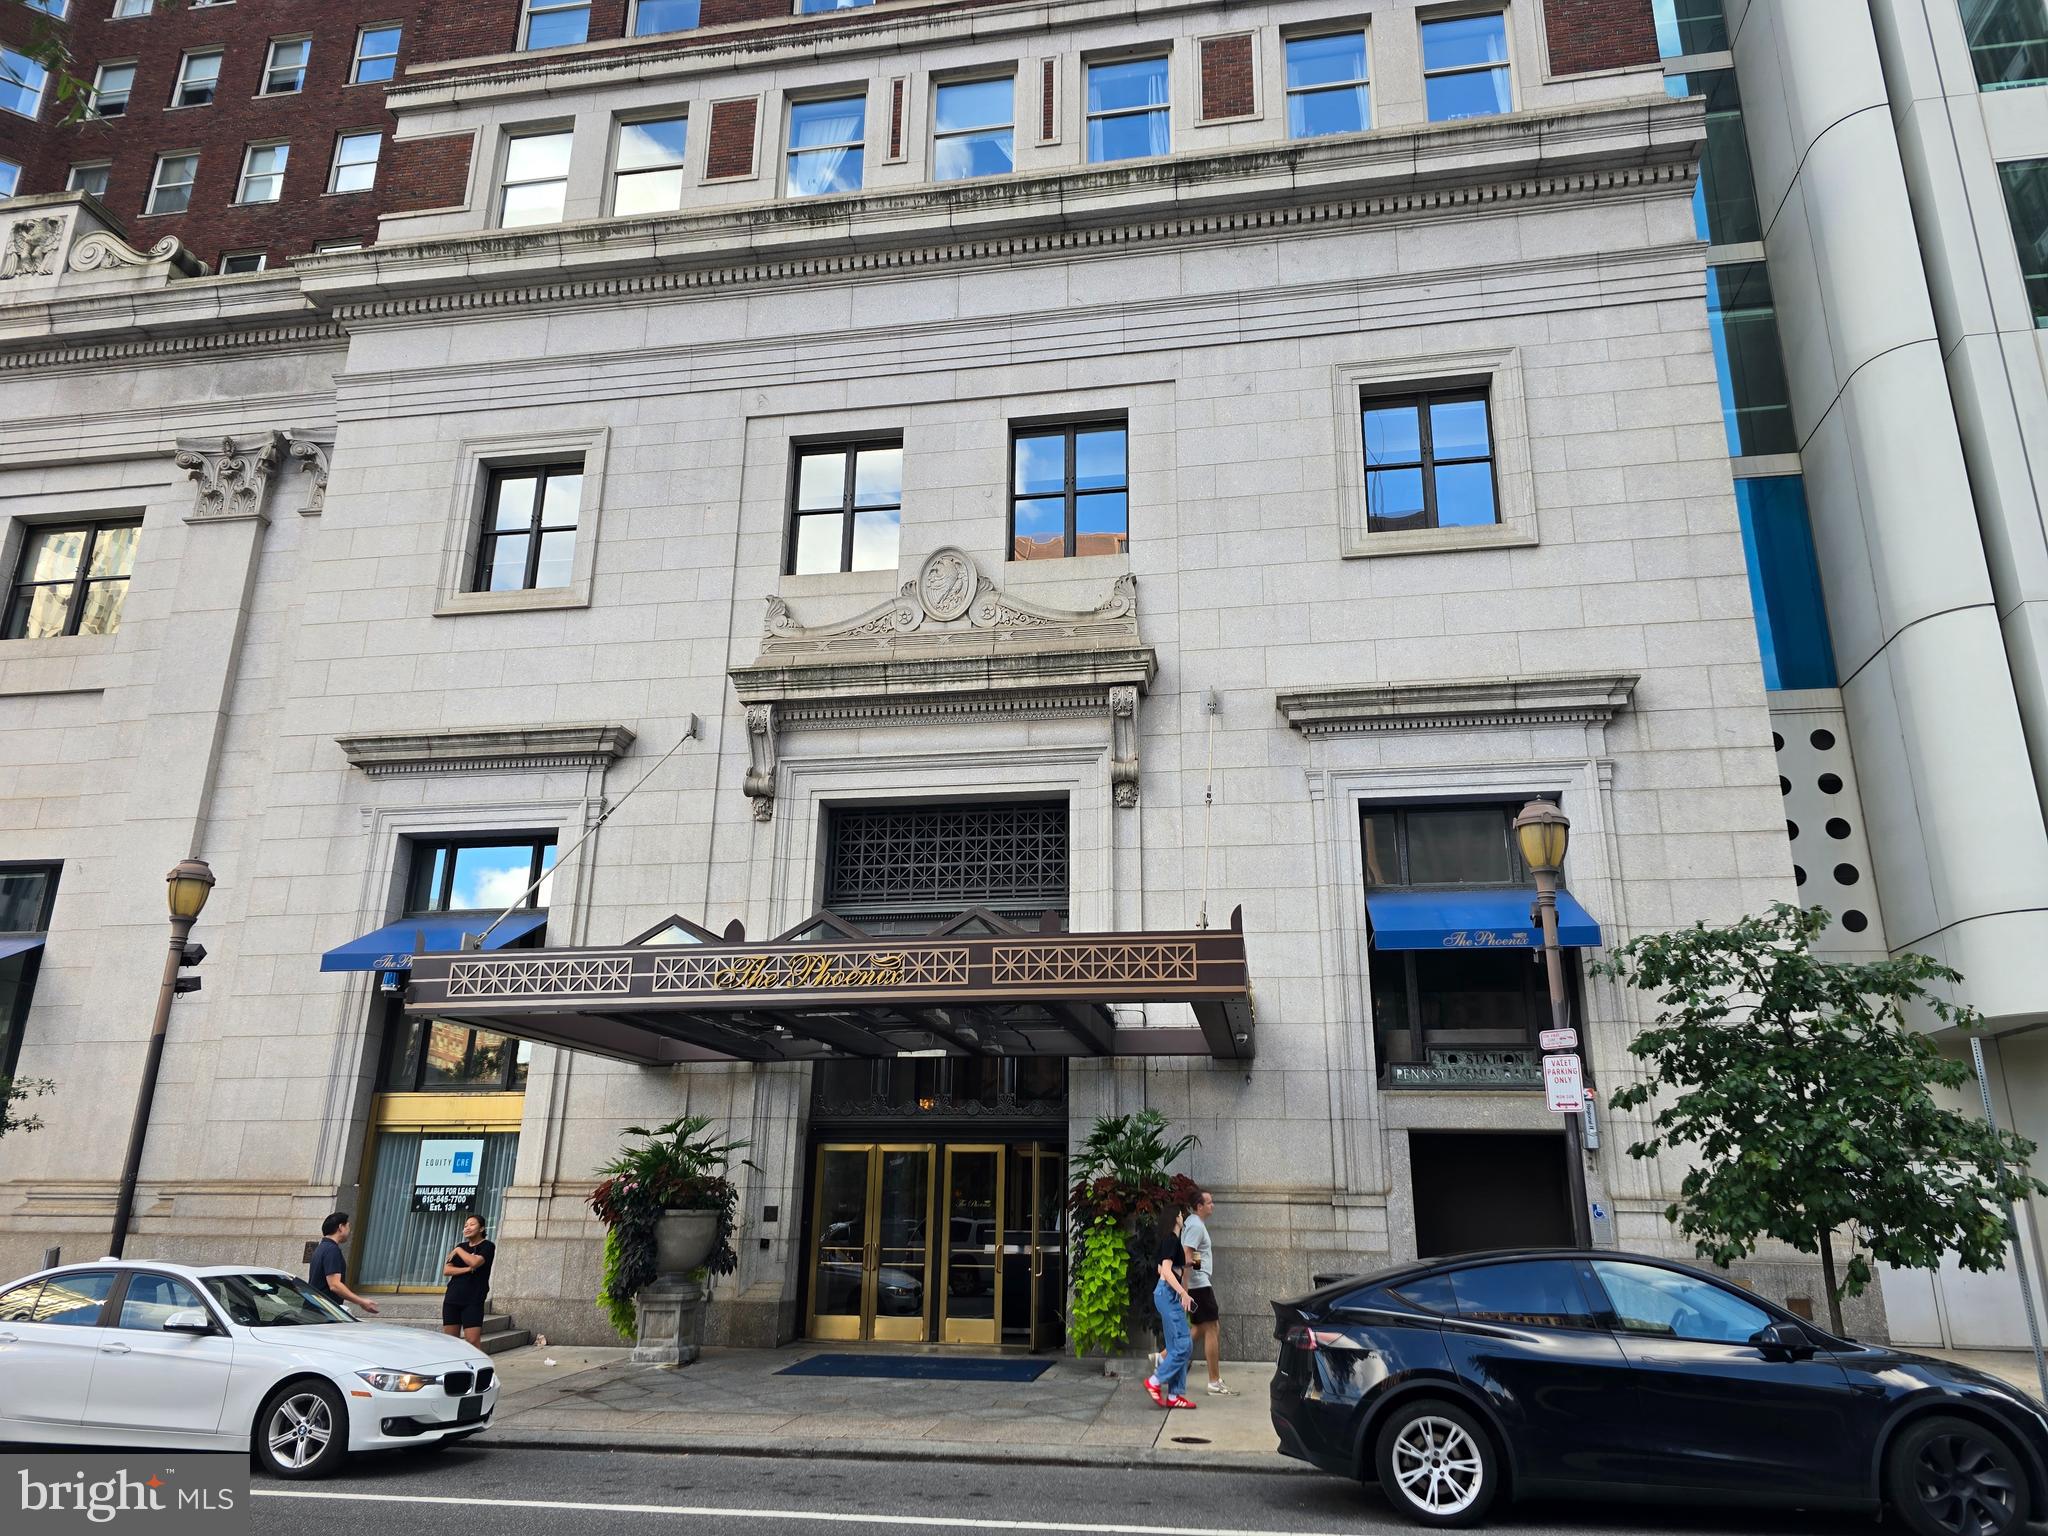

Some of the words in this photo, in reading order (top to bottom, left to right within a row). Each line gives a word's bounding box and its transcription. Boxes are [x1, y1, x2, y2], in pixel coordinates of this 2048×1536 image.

[1443, 931, 1473, 947] The
[1474, 930, 1529, 947] Phoenix
[373, 954, 397, 969] The
[715, 954, 779, 989] The
[786, 952, 905, 989] Phoenix
[1442, 1053, 1458, 1065] TO
[1466, 1053, 1524, 1065] STATION
[1551, 1059, 1573, 1067] VALET
[1396, 1067, 1497, 1080] PENNSYLVANIA
[1547, 1067, 1578, 1076] PARKING
[1554, 1076, 1572, 1084] ONLY
[425, 1158, 452, 1167] EQUITY
[456, 1158, 470, 1167] CRE
[415, 1187, 445, 1196] AVAILABLE
[445, 1187, 458, 1196] FOR
[457, 1187, 476, 1196] LEASE
